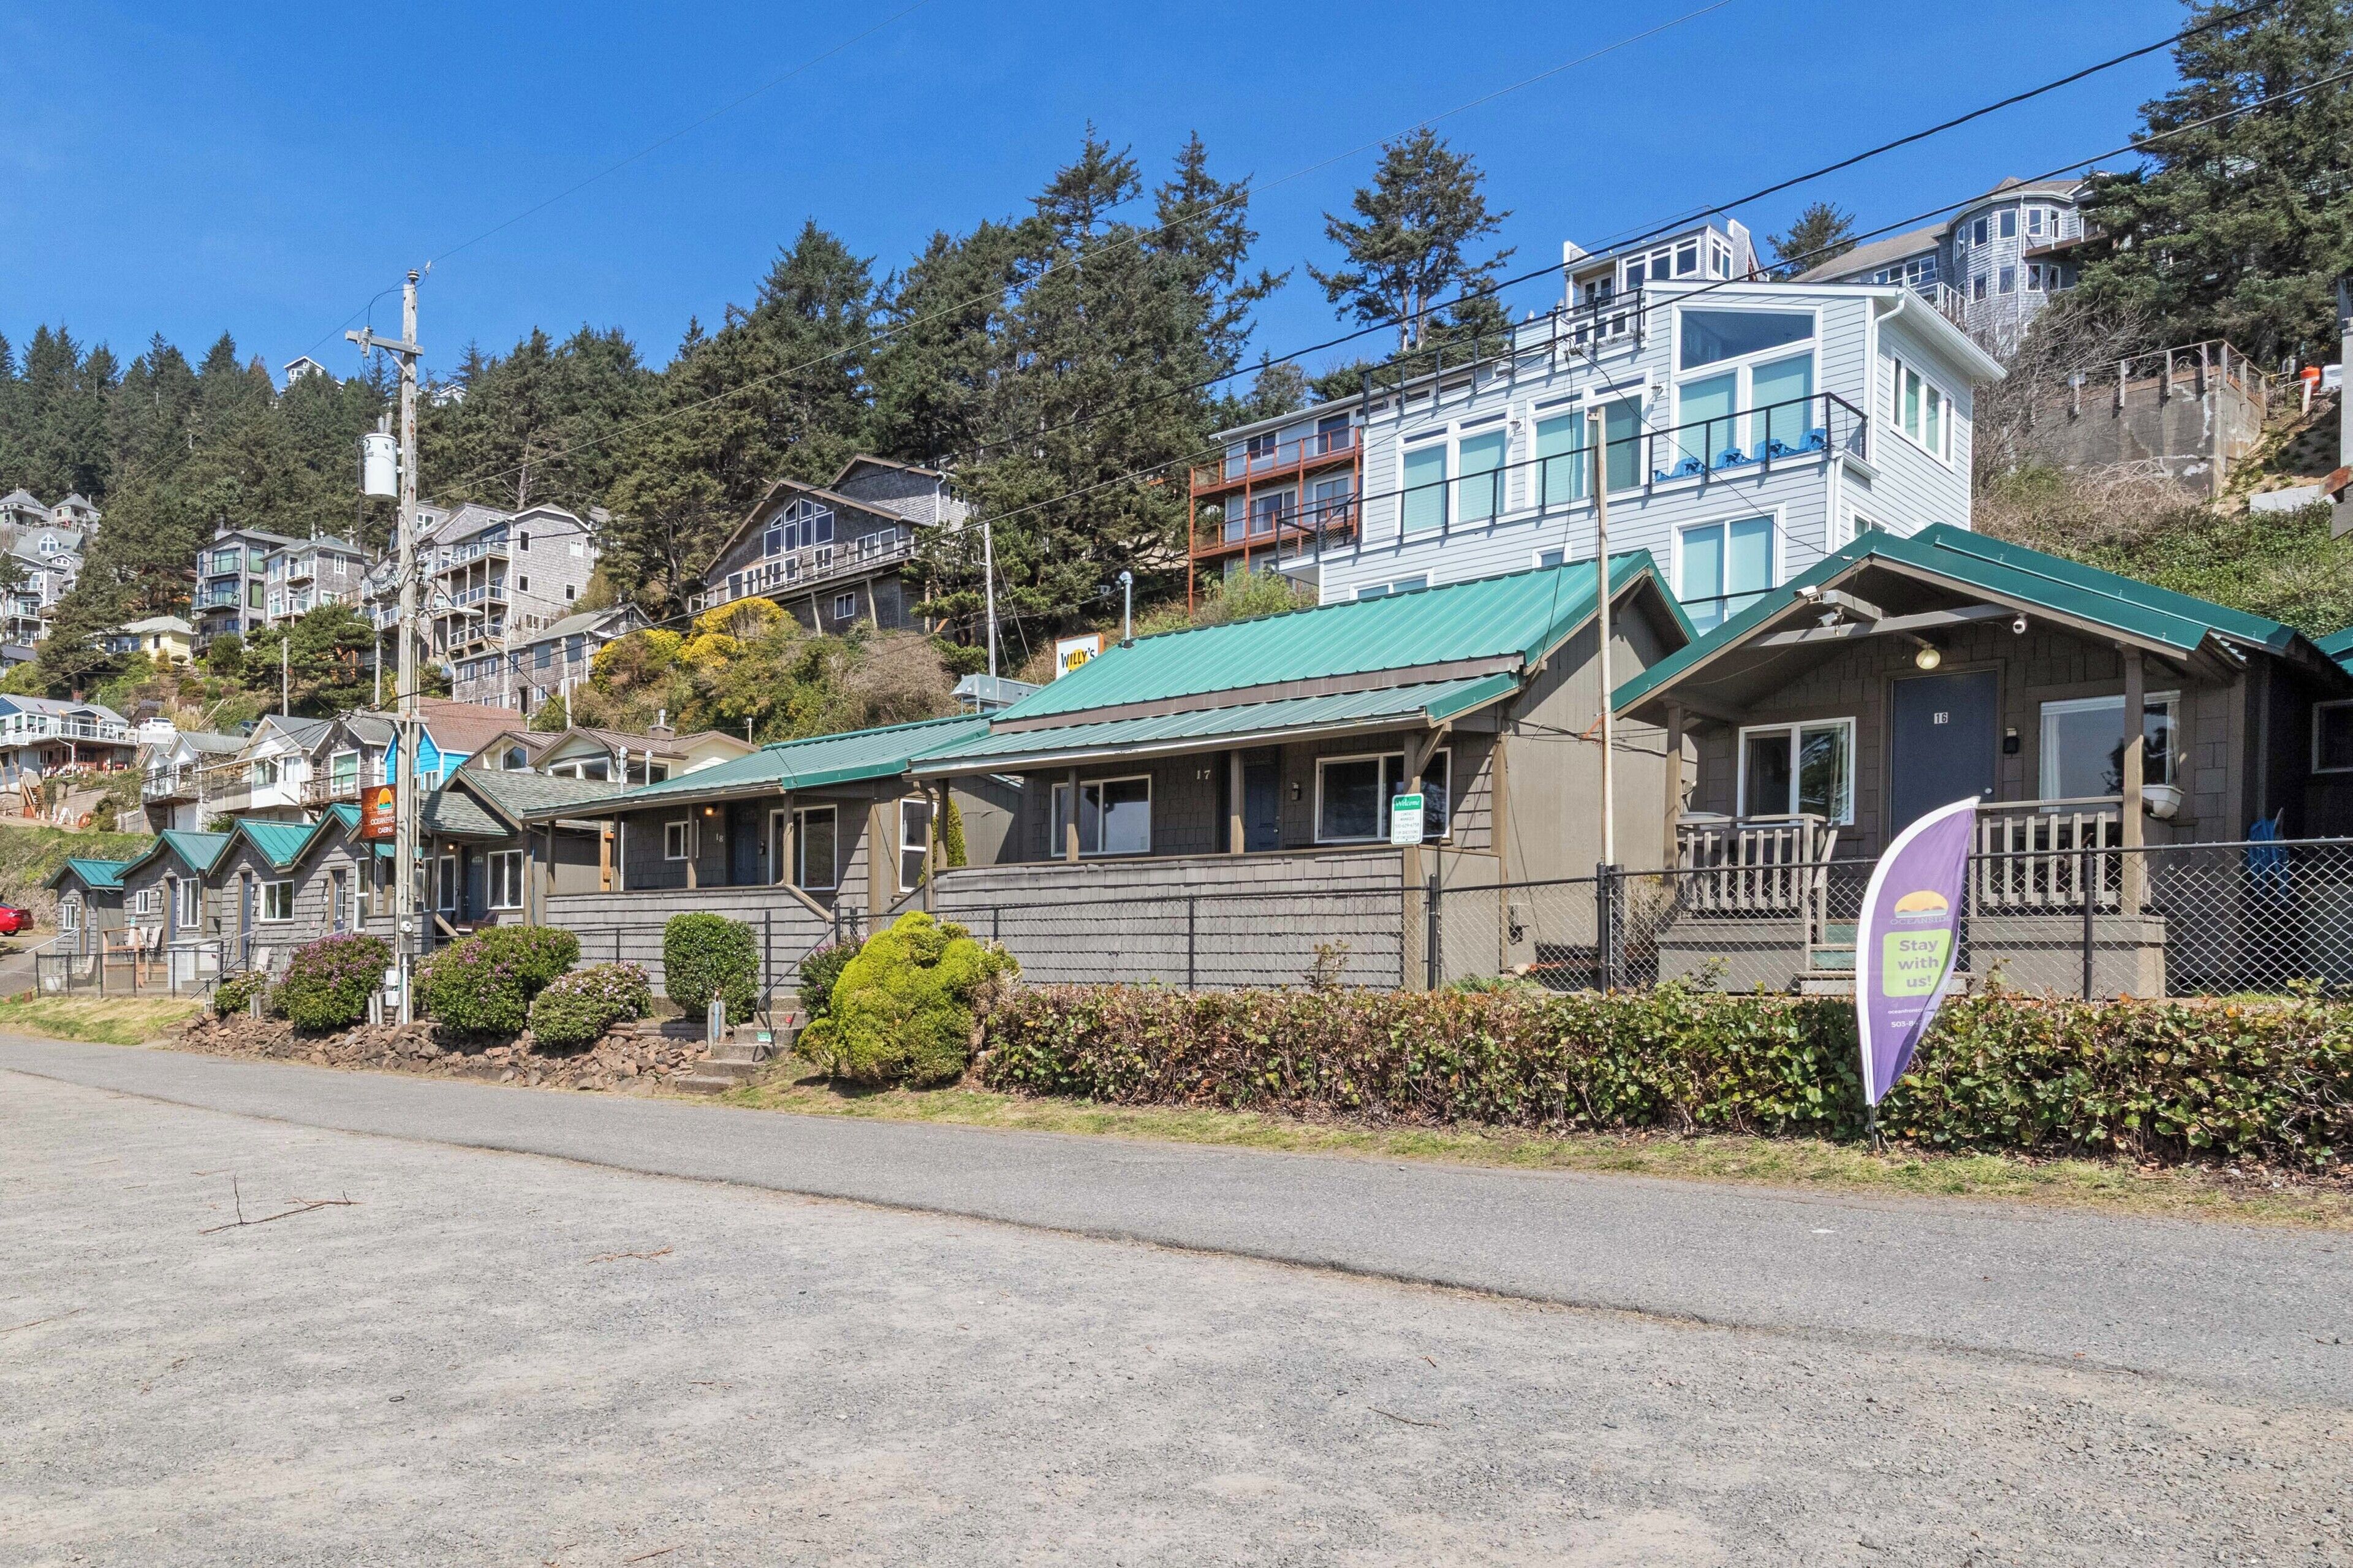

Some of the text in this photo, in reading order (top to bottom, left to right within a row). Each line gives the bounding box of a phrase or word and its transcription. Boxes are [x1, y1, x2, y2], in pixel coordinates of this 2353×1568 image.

[1061, 647, 1095, 668] WILLY'S
[1936, 713, 1947, 724] 16
[1196, 769, 1211, 780] 17
[1395, 798, 1420, 806] Welcome
[371, 816, 395, 825] OCEANFRO
[716, 833, 724, 843] 18
[1890, 915, 1951, 925] OCEANSIDE
[1899, 940, 1938, 952] Stay
[1898, 956, 1939, 970] with
[1906, 975, 1931, 987] us!
